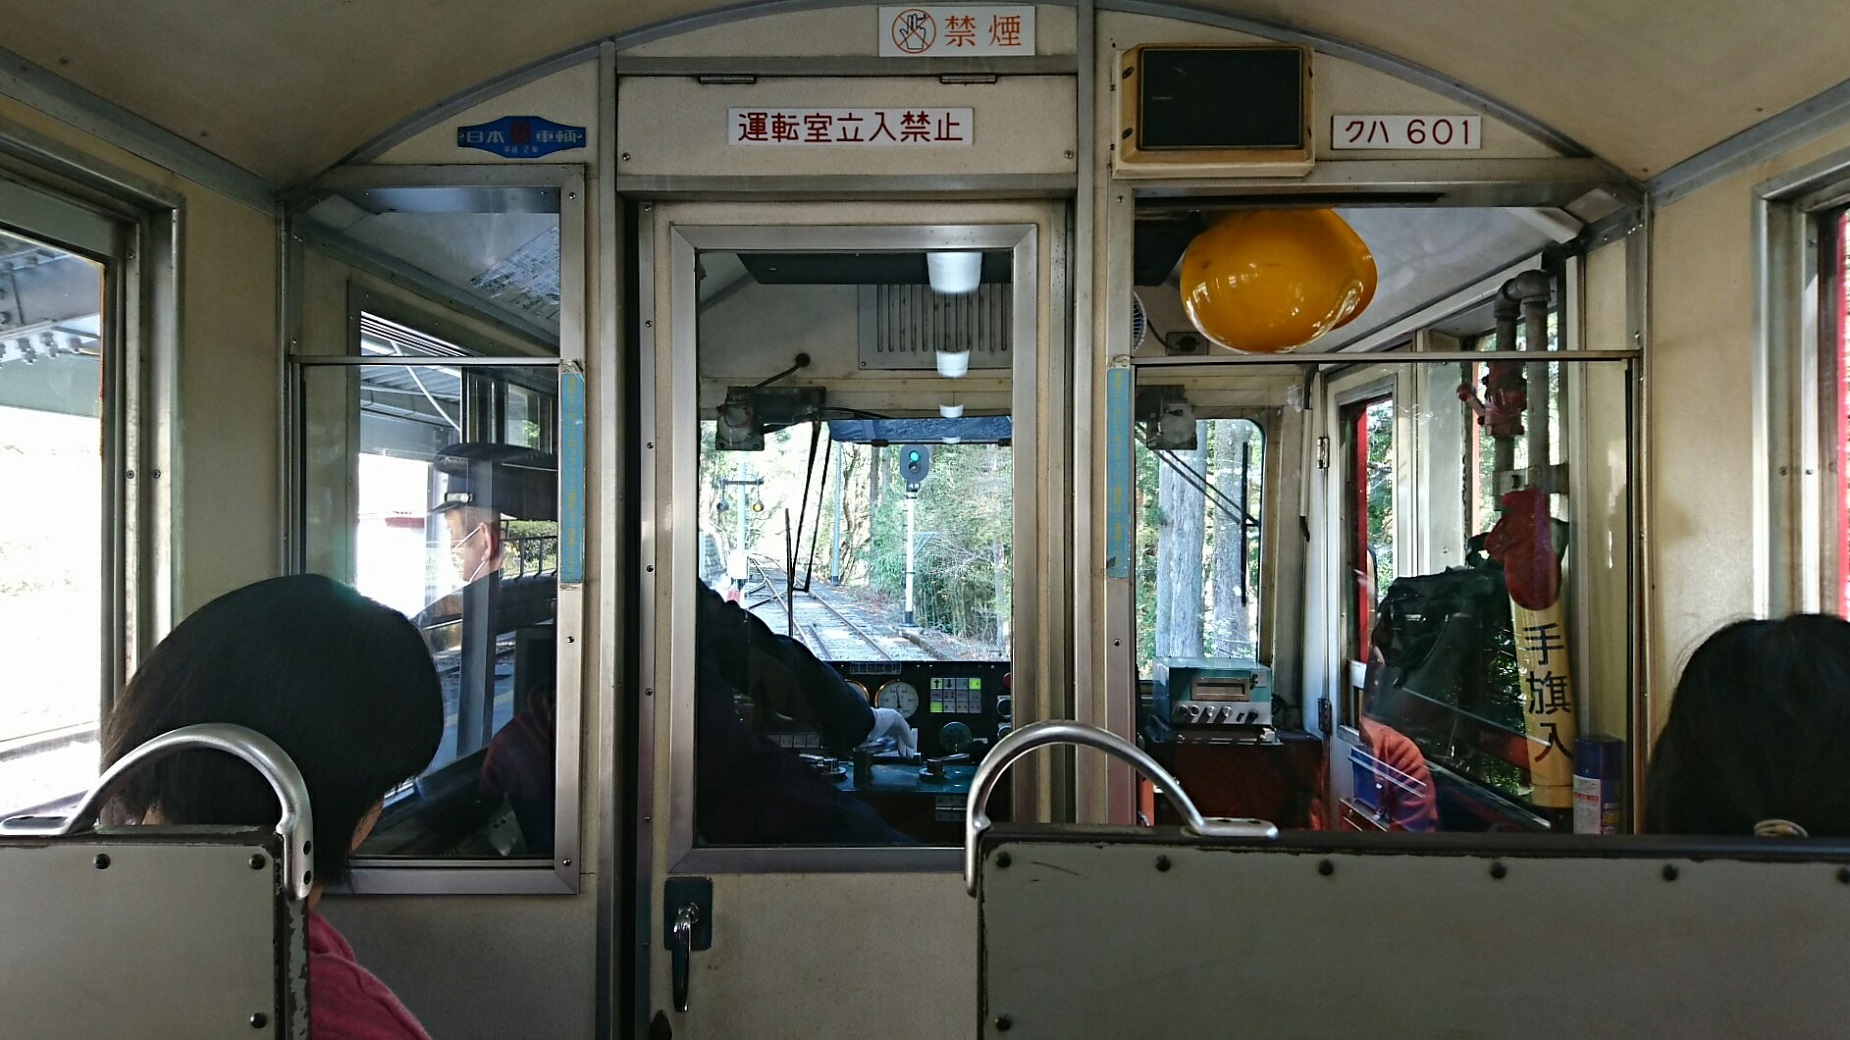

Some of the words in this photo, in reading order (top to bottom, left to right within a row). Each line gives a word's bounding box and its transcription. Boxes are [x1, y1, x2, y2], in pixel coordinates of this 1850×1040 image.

[944, 14, 1022, 47] 禁煙
[466, 130, 505, 143] 日本
[737, 110, 964, 143] 運転室立入禁止
[1345, 120, 1389, 143] クハ
[1407, 119, 1469, 145] 601
[1522, 622, 1574, 763] 手旗入
